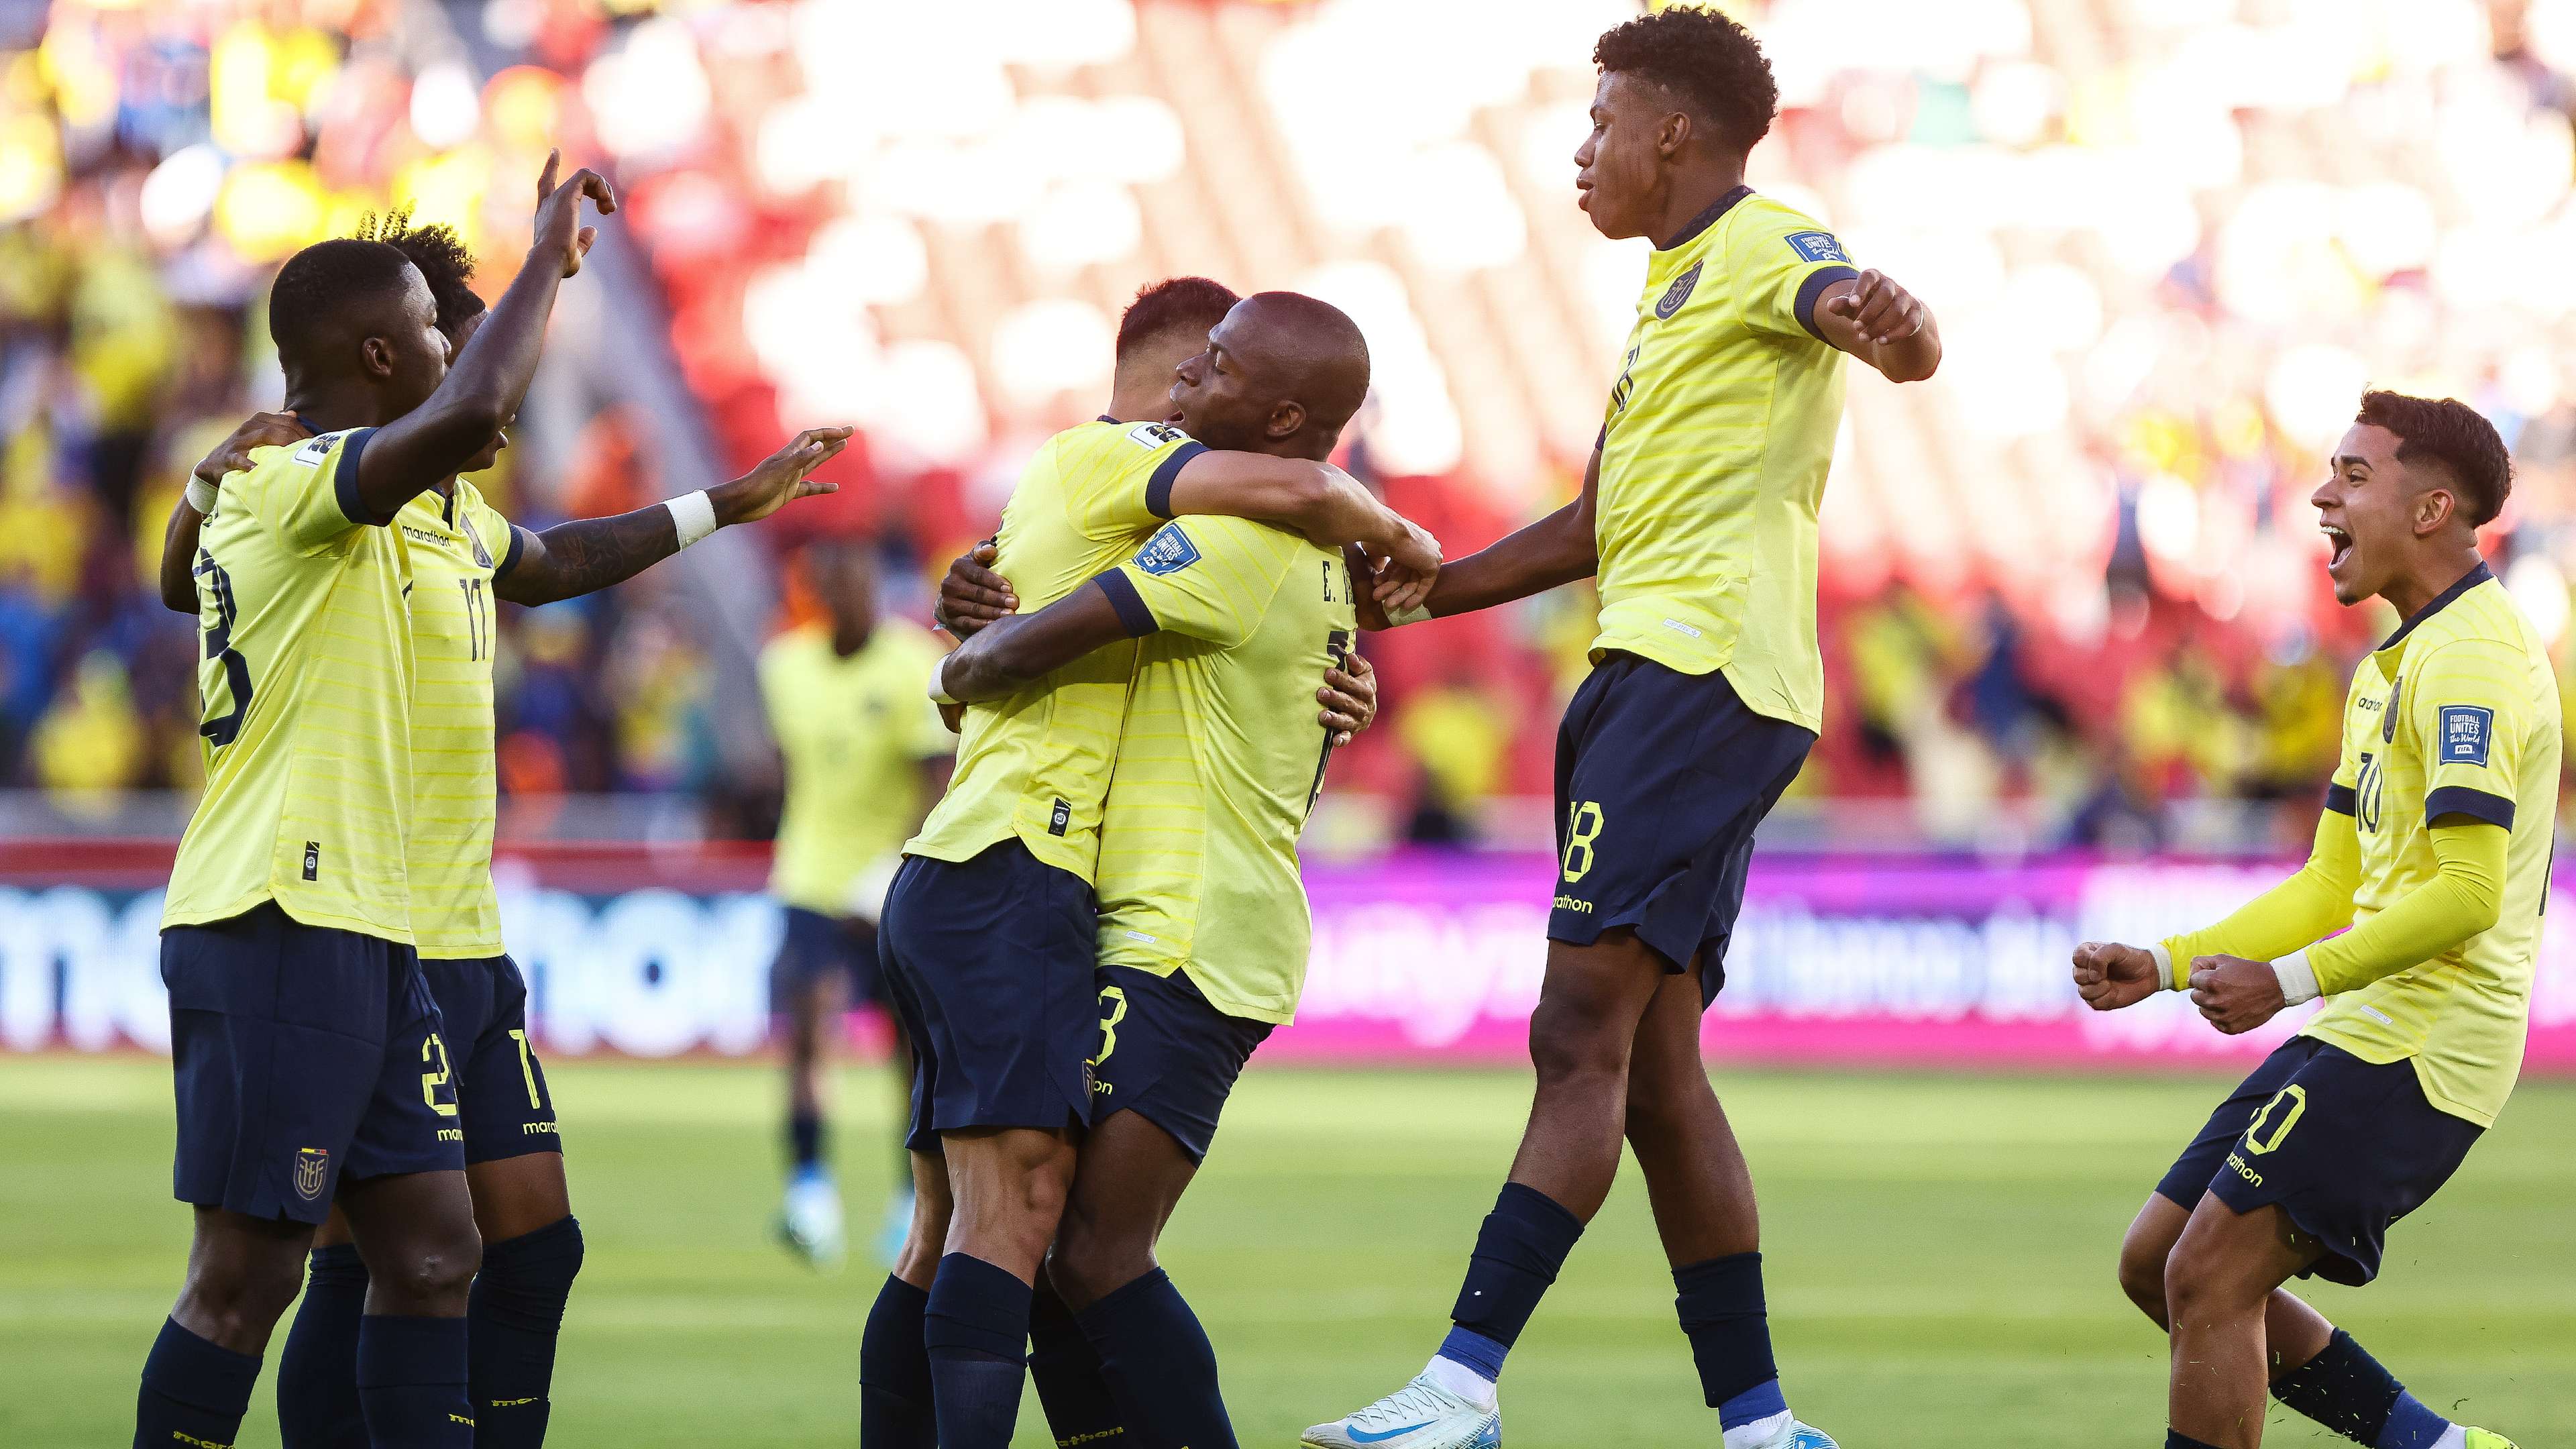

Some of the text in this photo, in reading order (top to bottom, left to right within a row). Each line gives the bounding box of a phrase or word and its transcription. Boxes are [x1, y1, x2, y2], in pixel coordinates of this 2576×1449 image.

[1805, 241, 1834, 249] UNITE
[402, 525, 451, 547] marathon
[1165, 532, 1184, 555] FOOTBALL
[1157, 537, 1178, 561] UNITES
[2450, 714, 2480, 724] FOOTBALL
[2450, 722, 2480, 735] UNITES
[2449, 733, 2481, 745] the World
[1553, 894, 1593, 914] rathon
[1097, 985, 1128, 1066] 3
[422, 1033, 458, 1116] 2
[1094, 1080, 1113, 1095] on
[2226, 1150, 2263, 1187] rathon
